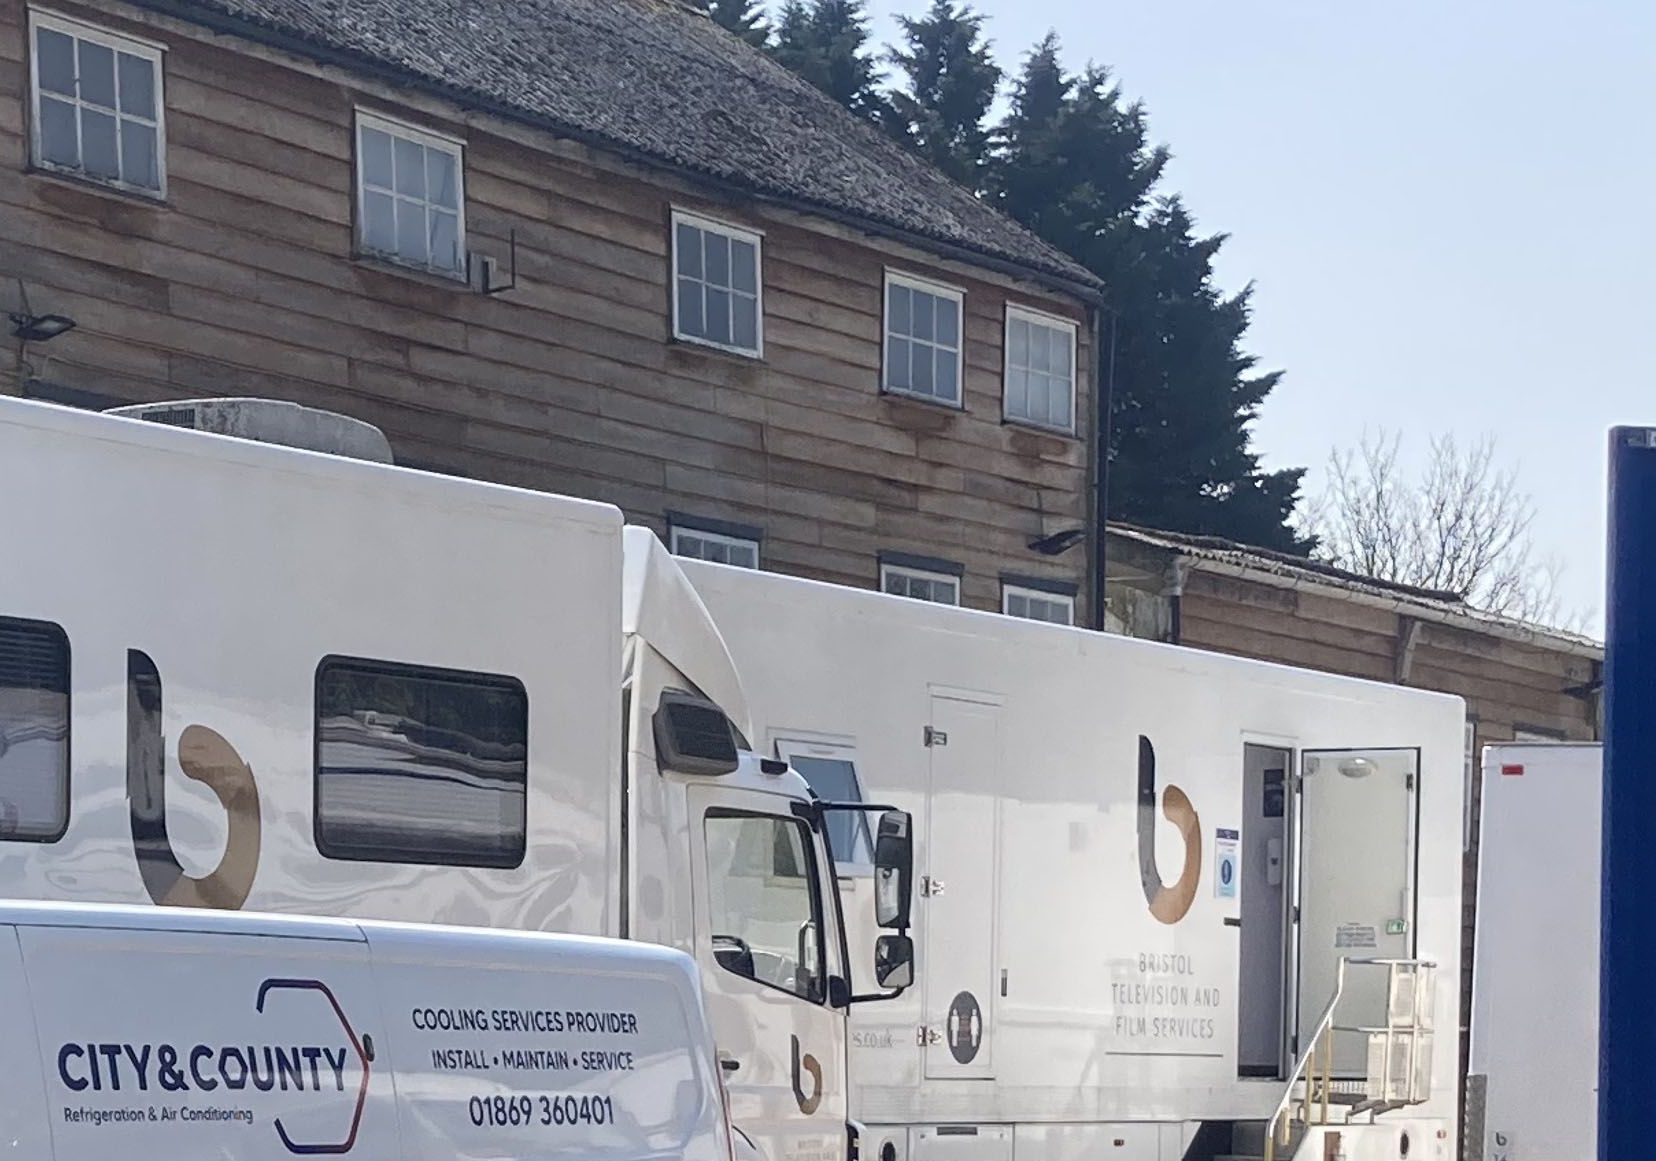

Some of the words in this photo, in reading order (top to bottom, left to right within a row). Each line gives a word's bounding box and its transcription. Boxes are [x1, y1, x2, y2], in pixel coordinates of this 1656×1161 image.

[1139, 952, 1194, 976] BRISTOL
[1111, 983, 1188, 1006] TELEVISION
[1195, 987, 1221, 1008] AND
[412, 1008, 489, 1031] COOLING
[493, 1010, 563, 1032] SERVICES
[566, 1011, 638, 1034] PROVIDER
[1115, 1015, 1146, 1037] FILM
[1153, 1016, 1214, 1039] SERVICES
[57, 1043, 346, 1092] CITY&COUNTY
[432, 1049, 489, 1069] INSTALL
[502, 1050, 569, 1070] MAINTAIN
[581, 1051, 634, 1071] SERVICE
[64, 1106, 144, 1126] Refrigeration
[148, 1107, 158, 1121] &
[161, 1106, 177, 1121] Air
[180, 1106, 253, 1124] Conditioning
[469, 1095, 532, 1126] 01869
[539, 1095, 614, 1125] 360401
